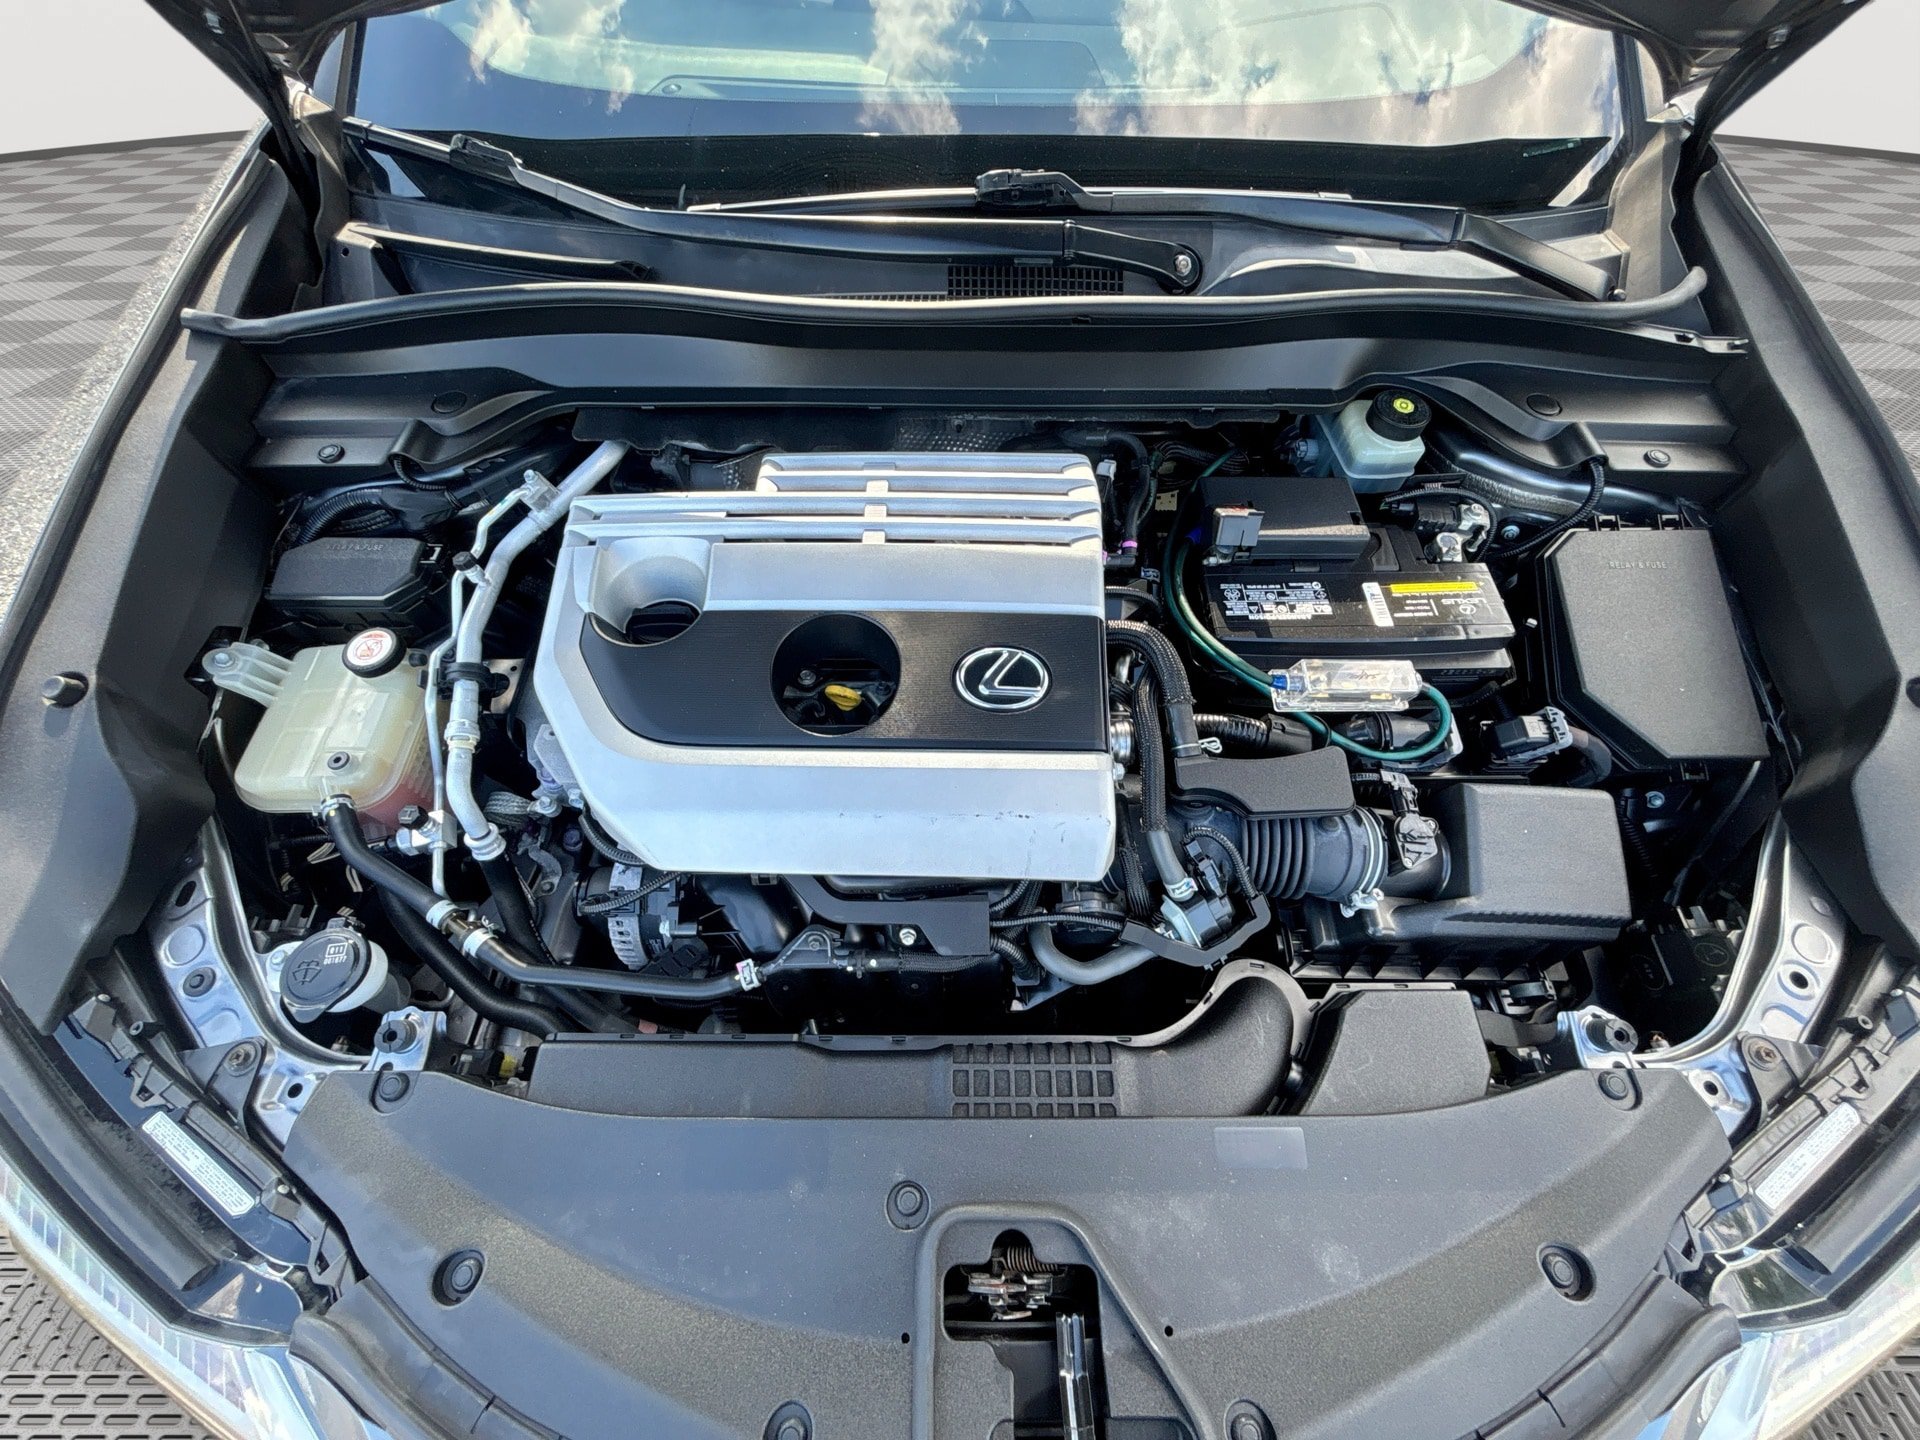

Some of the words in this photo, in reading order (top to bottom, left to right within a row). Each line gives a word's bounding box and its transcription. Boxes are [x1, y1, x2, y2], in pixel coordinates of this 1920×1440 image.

[1608, 561, 1635, 569] RELAY
[1645, 561, 1667, 569] FUSE
[1440, 597, 1487, 605] LEXUS
